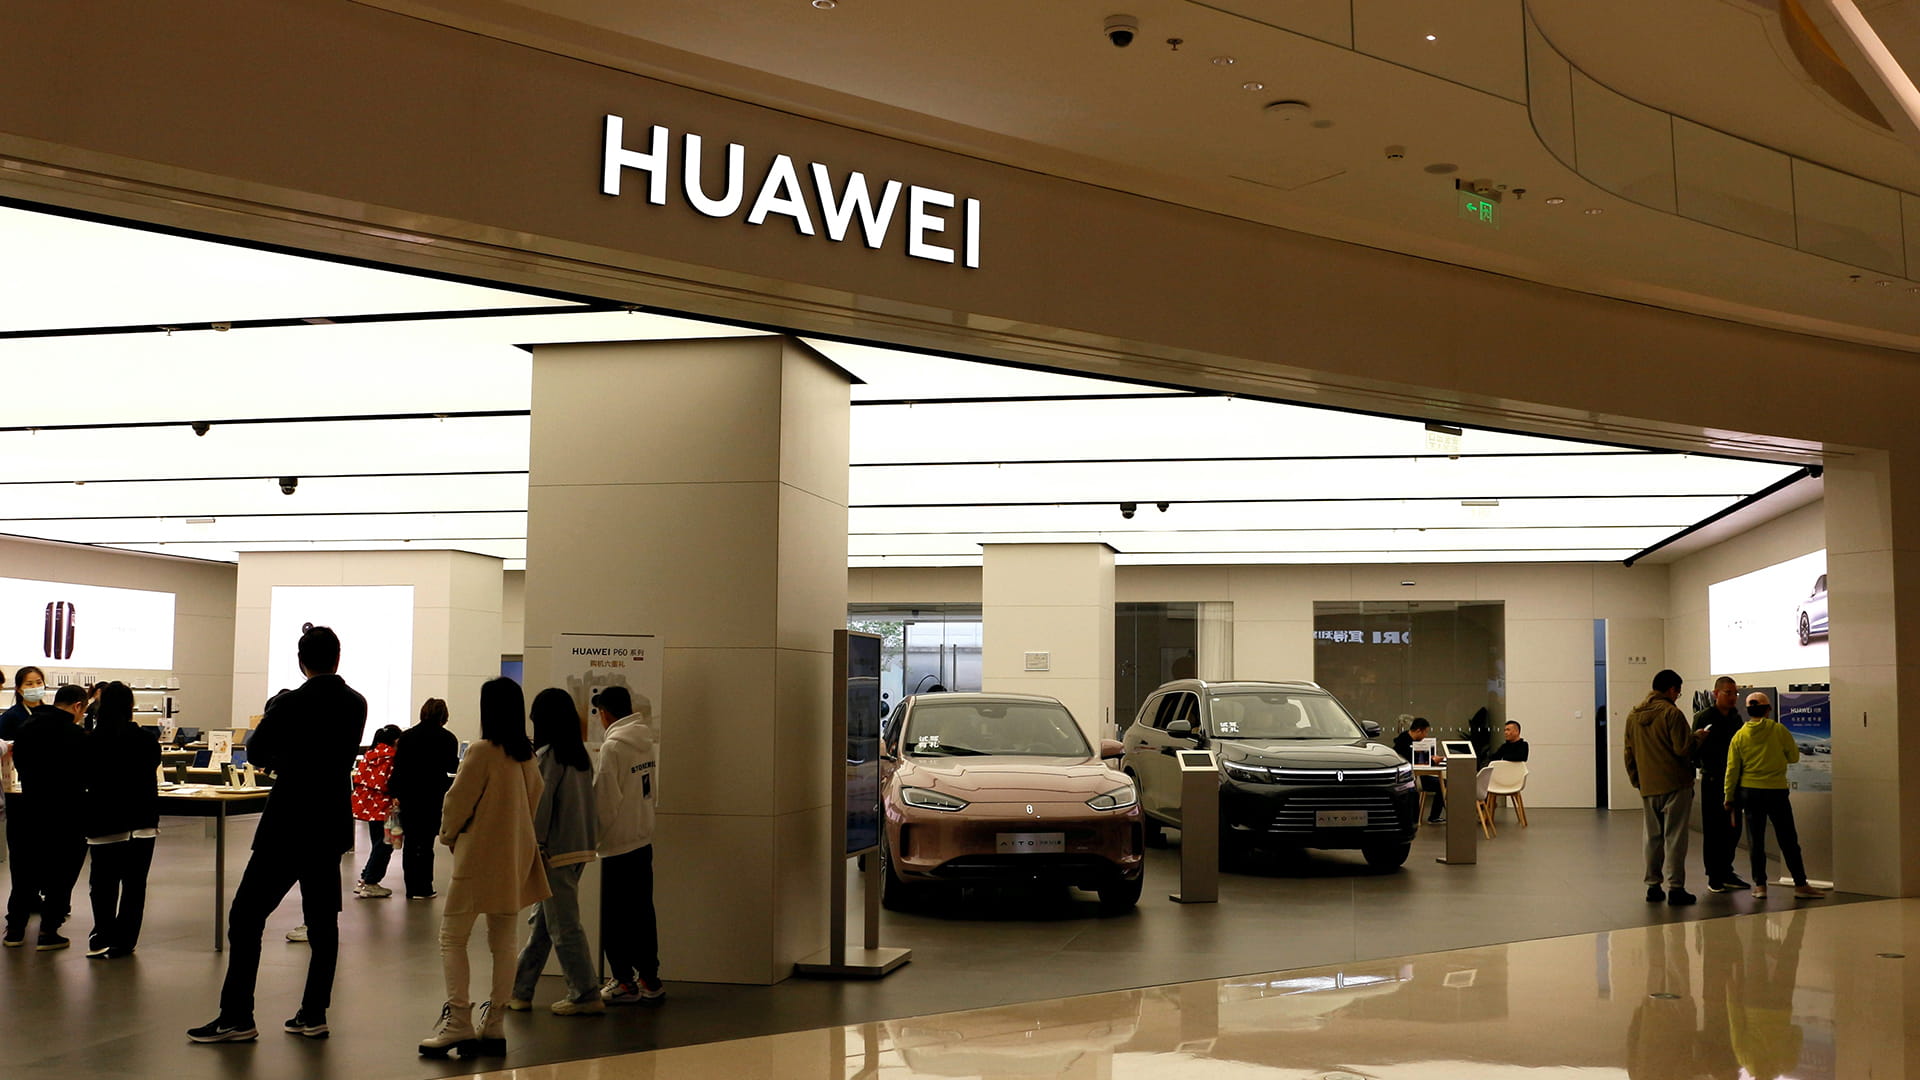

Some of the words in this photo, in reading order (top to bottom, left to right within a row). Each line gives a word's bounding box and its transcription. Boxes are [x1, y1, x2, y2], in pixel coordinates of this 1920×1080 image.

[602, 114, 980, 269] HUAWEI
[572, 648, 611, 656] HUAWEI
[613, 648, 628, 656] P60
[630, 648, 644, 656] 系列
